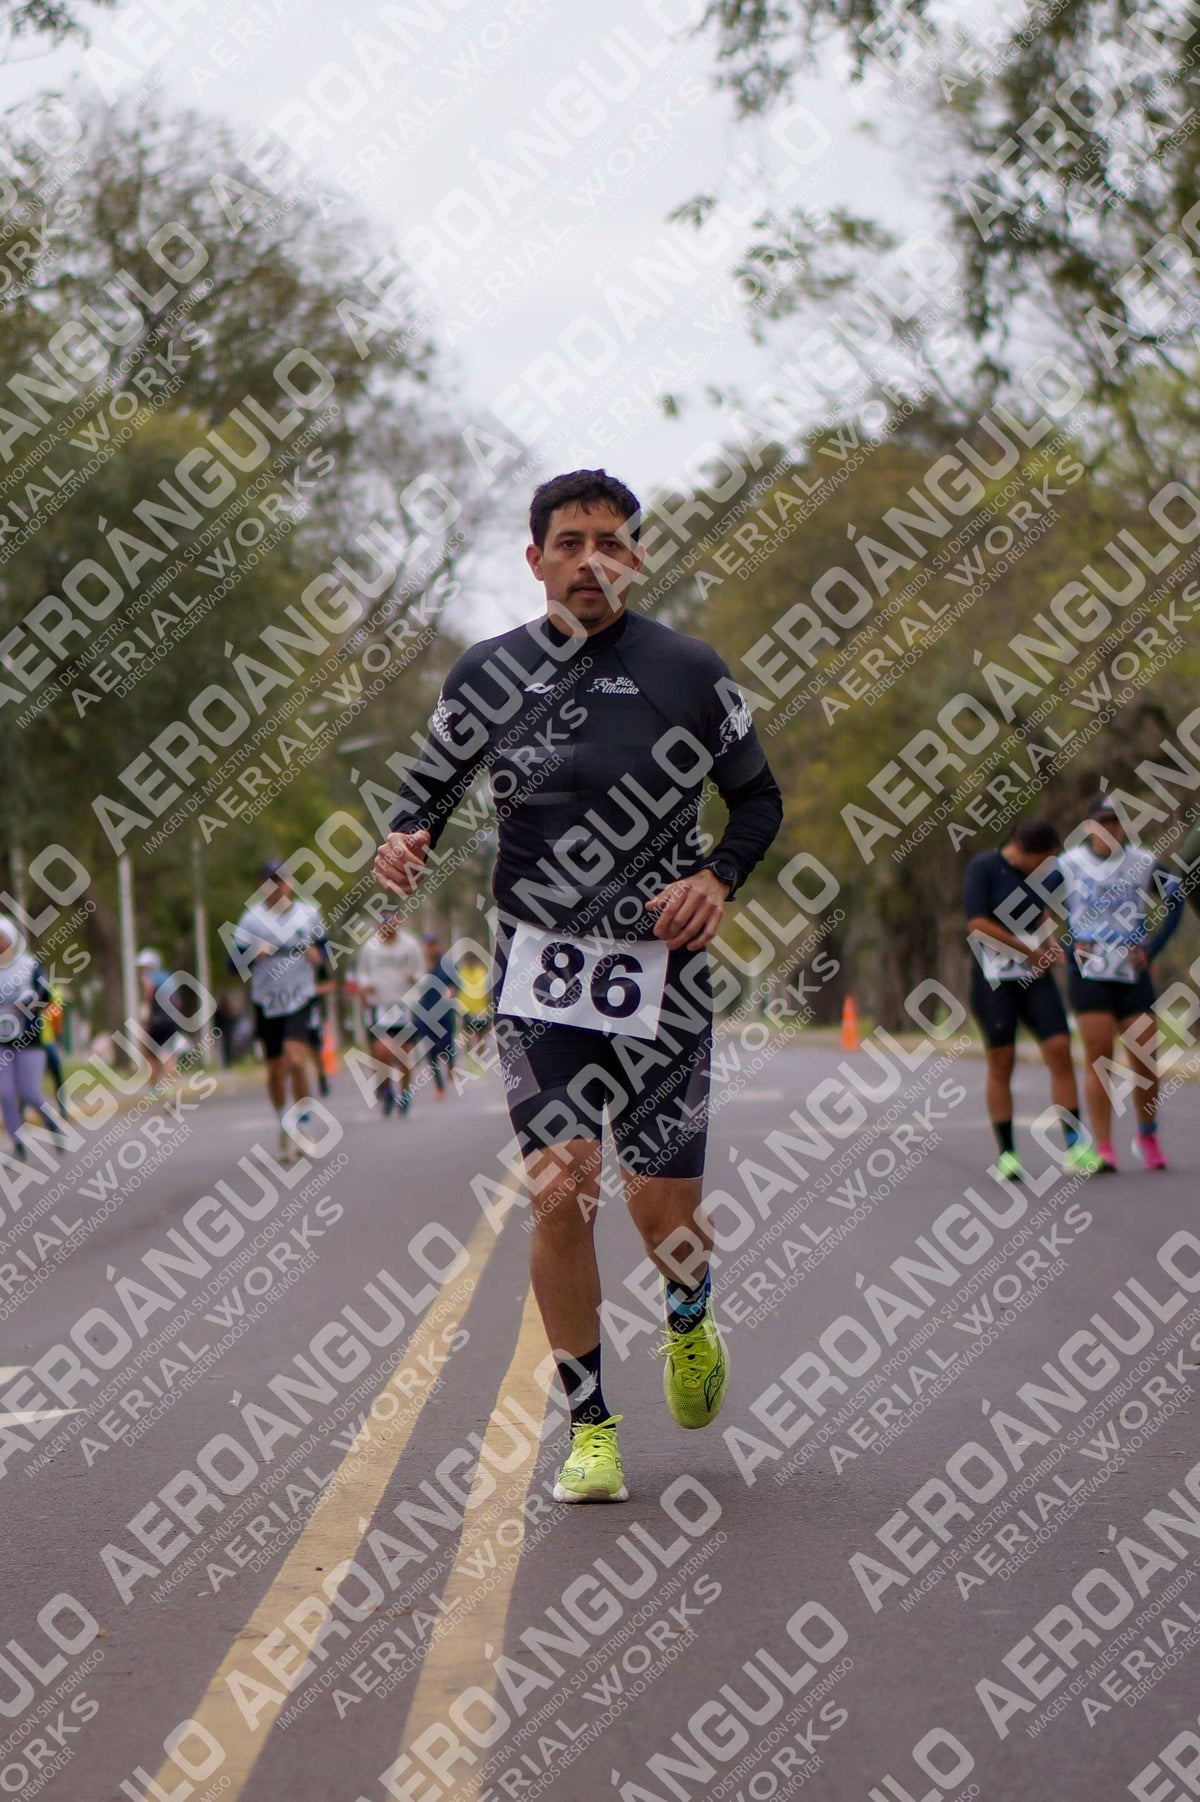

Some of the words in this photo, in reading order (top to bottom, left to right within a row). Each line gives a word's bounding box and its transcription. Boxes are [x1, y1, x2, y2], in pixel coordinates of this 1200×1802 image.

[602, 681, 639, 695] Mundo
[616, 676, 633, 687] Bici
[532, 941, 643, 1019] 86
